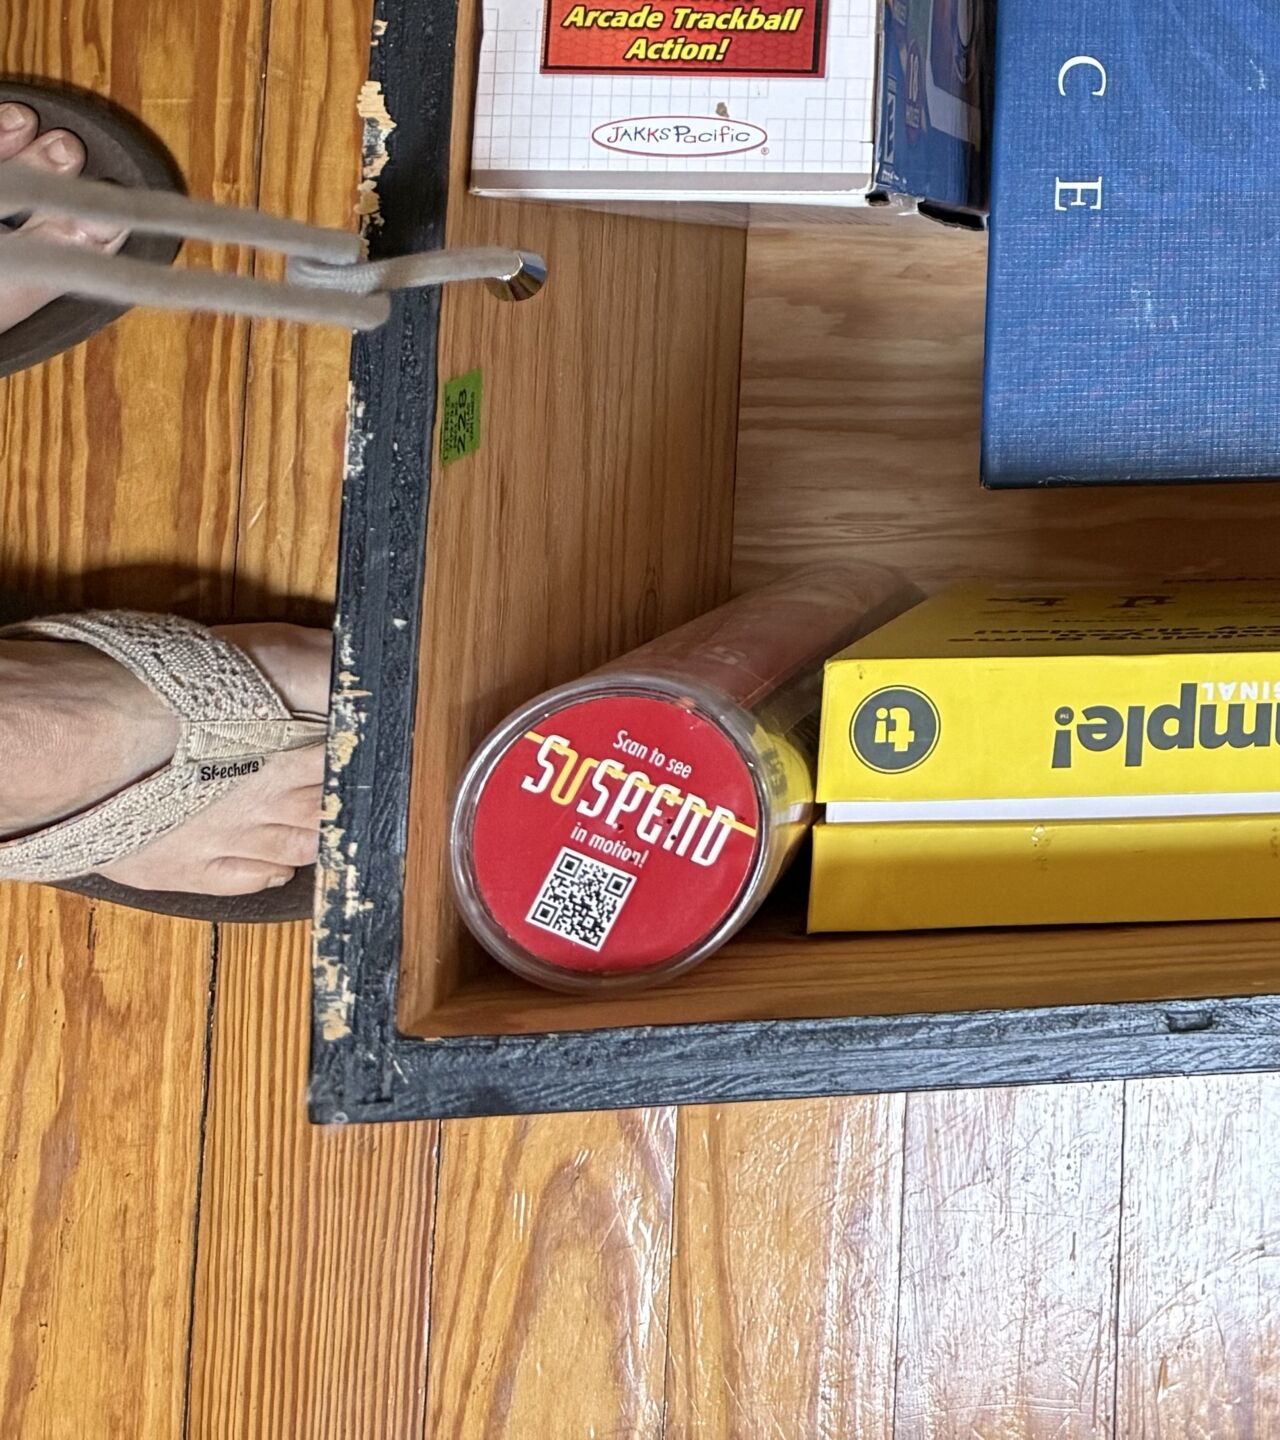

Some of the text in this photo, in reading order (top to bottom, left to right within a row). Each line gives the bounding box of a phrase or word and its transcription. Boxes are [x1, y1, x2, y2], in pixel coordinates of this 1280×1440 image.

[561, 5, 804, 33] Arcade Trackball
[624, 36, 732, 62] Action!
[605, 124, 751, 145] JAKKS Pacific
[612, 728, 693, 780] Scan to see
[200, 759, 260, 782] Skechers
[520, 733, 735, 868] SUSPEND
[569, 822, 650, 869] in motion!
